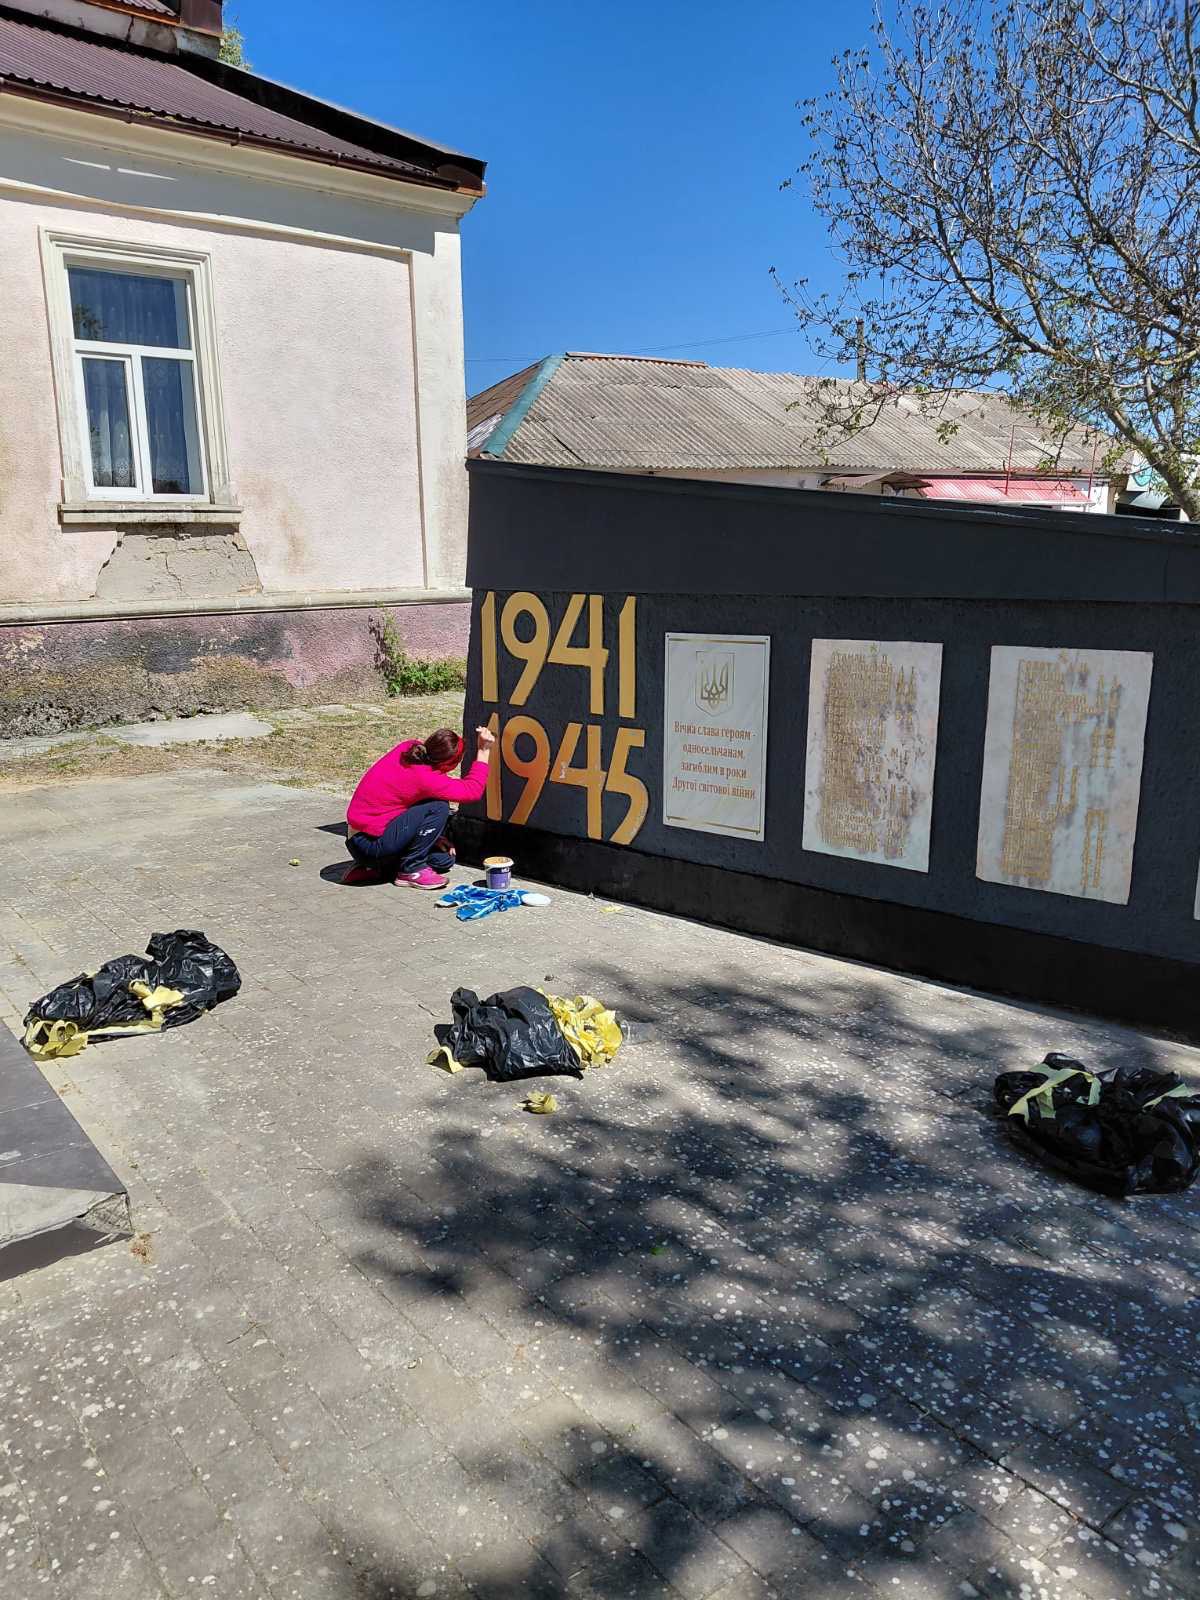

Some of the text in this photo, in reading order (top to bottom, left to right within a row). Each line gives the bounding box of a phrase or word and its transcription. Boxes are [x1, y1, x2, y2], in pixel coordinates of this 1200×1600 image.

[481, 591, 637, 719] 1941
[674, 721, 696, 734] Вічна
[697, 726, 720, 736] слава
[485, 712, 649, 845] 1945
[726, 767, 747, 779] роки
[672, 777, 697, 792] Другої
